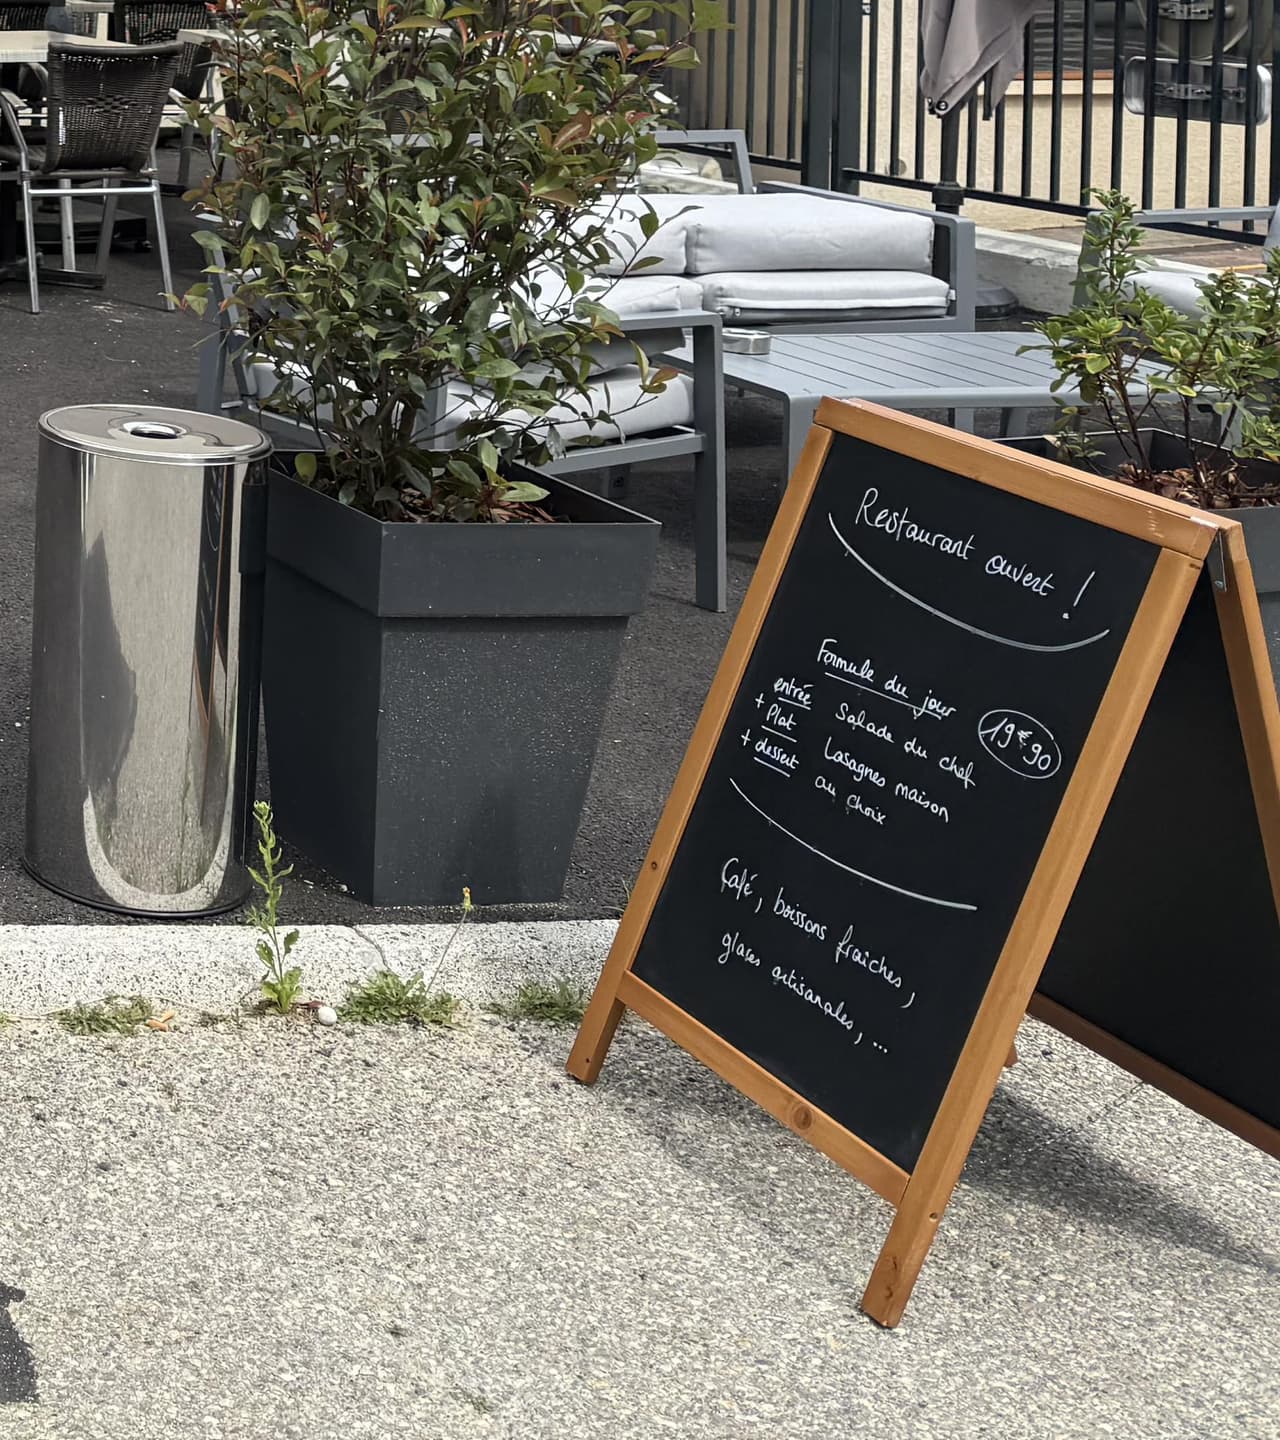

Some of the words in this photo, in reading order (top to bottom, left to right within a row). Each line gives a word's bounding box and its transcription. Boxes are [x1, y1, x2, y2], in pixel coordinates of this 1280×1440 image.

[855, 487, 976, 560] Restaurant
[816, 639, 874, 682] Formule
[884, 675, 909, 699] du
[918, 690, 957, 718] jour
[766, 703, 797, 731] Plat
[824, 736, 886, 788] Lasagnes
[895, 781, 950, 823] maison
[773, 677, 814, 705] entrée
[835, 703, 895, 743] Salade
[904, 737, 928, 759] du
[939, 755, 977, 789] chef
[754, 739, 800, 770] dessert
[815, 775, 836, 797] au
[846, 794, 887, 826] choix
[719, 932, 761, 964] glaces
[774, 887, 828, 940] boissons
